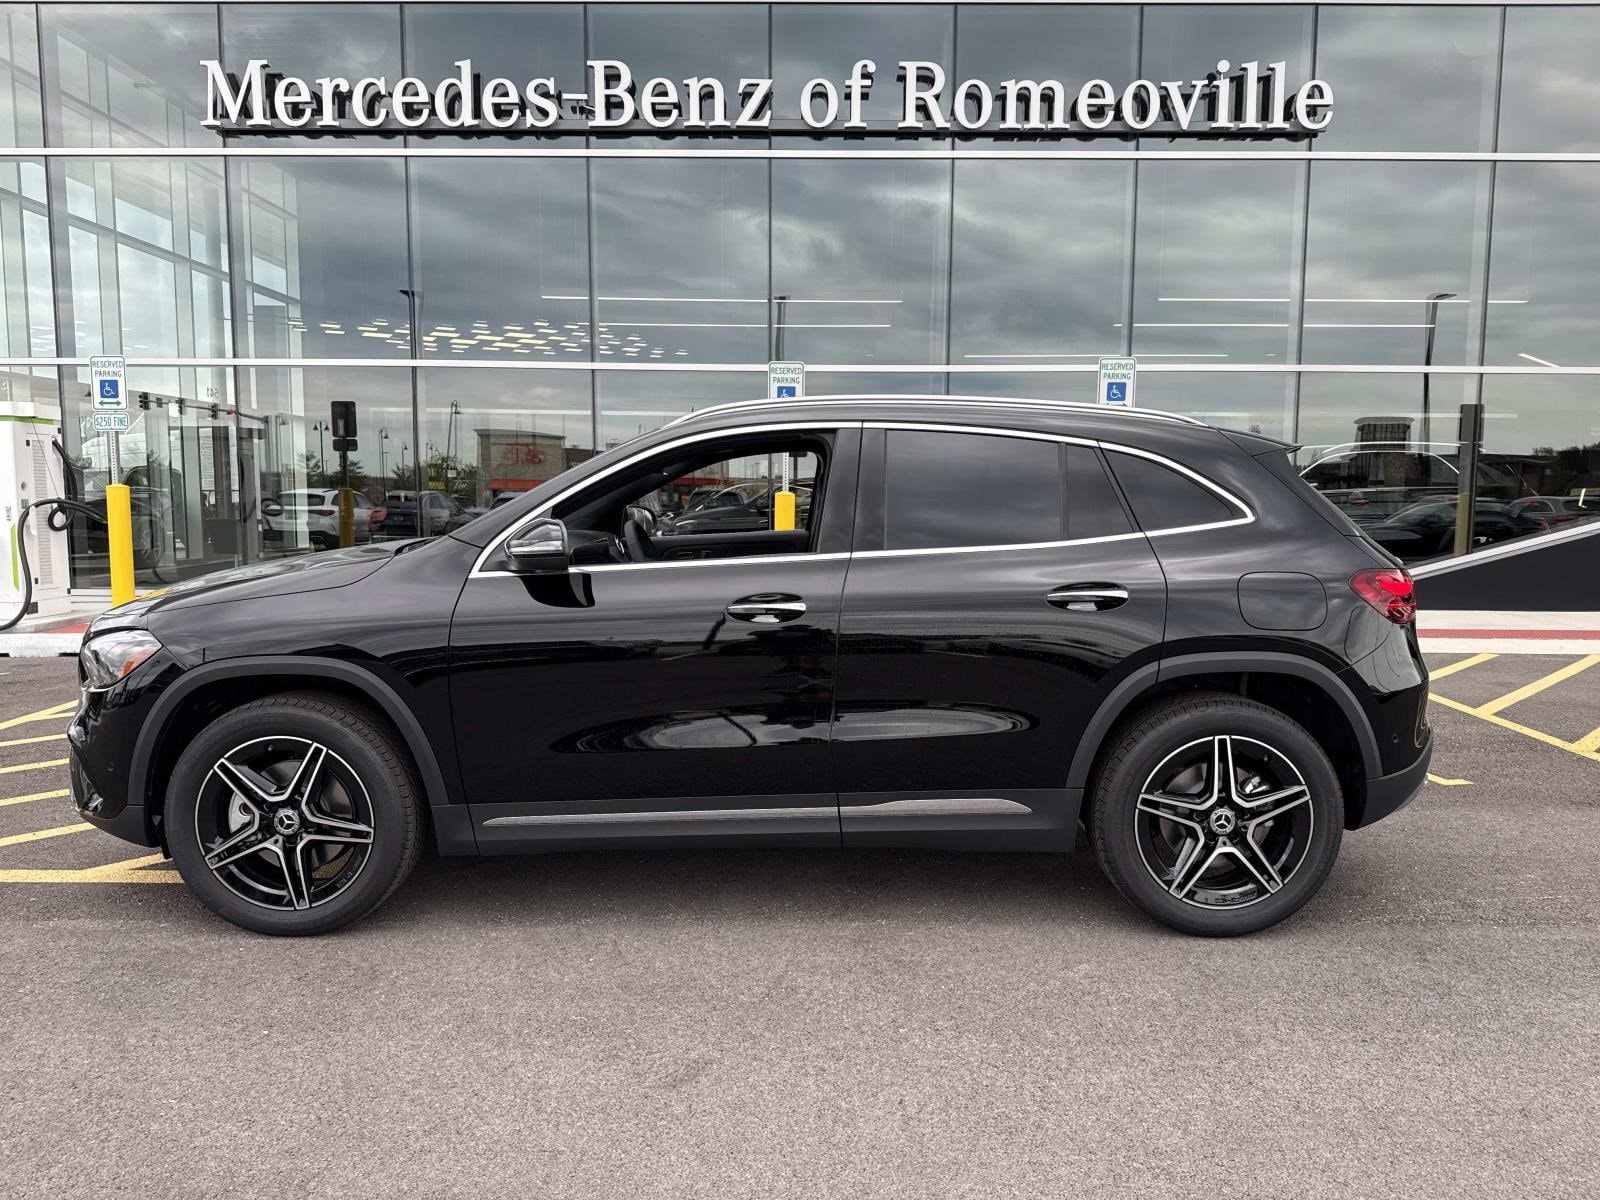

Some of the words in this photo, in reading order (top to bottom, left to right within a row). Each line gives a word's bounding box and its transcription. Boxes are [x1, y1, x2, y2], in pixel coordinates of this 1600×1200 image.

[200, 59, 774, 129] Mercedes-Benz
[800, 60, 876, 128] of
[898, 59, 1334, 130] Romeoville
[1101, 362, 1134, 370] RESERVED
[95, 416, 112, 426] $250
[114, 416, 127, 426] FINE
